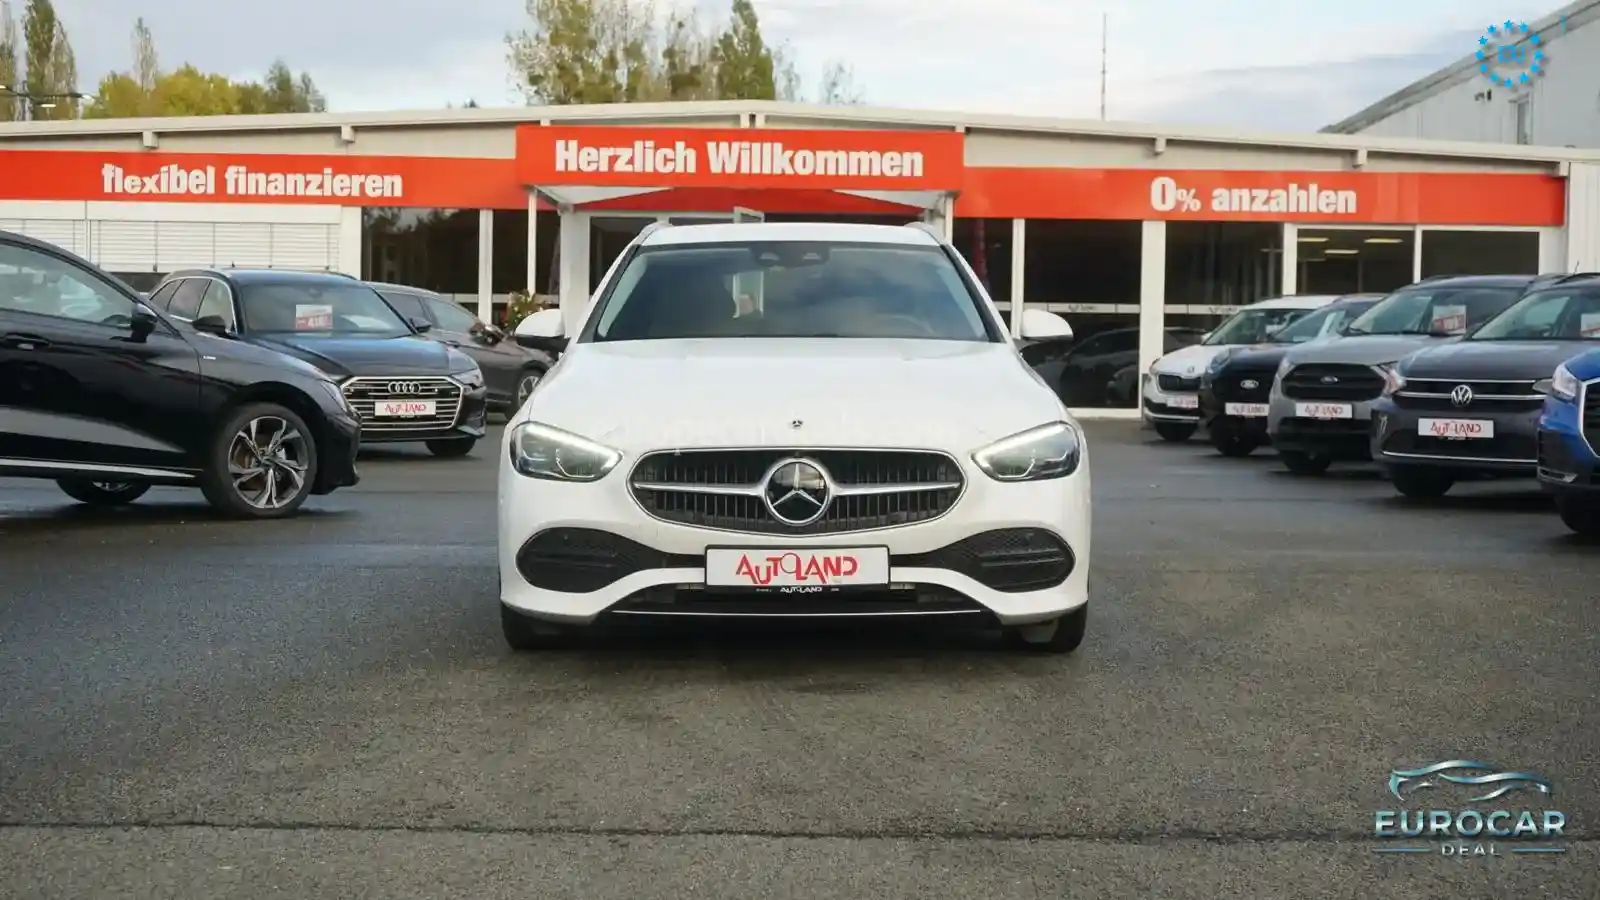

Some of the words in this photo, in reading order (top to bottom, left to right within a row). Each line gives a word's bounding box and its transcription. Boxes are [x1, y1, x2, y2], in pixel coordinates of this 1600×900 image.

[555, 139, 697, 173] Herzlich
[707, 141, 923, 177] Willkommen
[102, 163, 215, 195] flexibel
[225, 165, 403, 198] finanzieren
[1150, 176, 1201, 213] 0%
[1211, 183, 1357, 214] anzahlen
[384, 403, 427, 414] AUTLAND
[1304, 404, 1344, 417] AUTLAND
[735, 552, 858, 585] AUTOLAND
